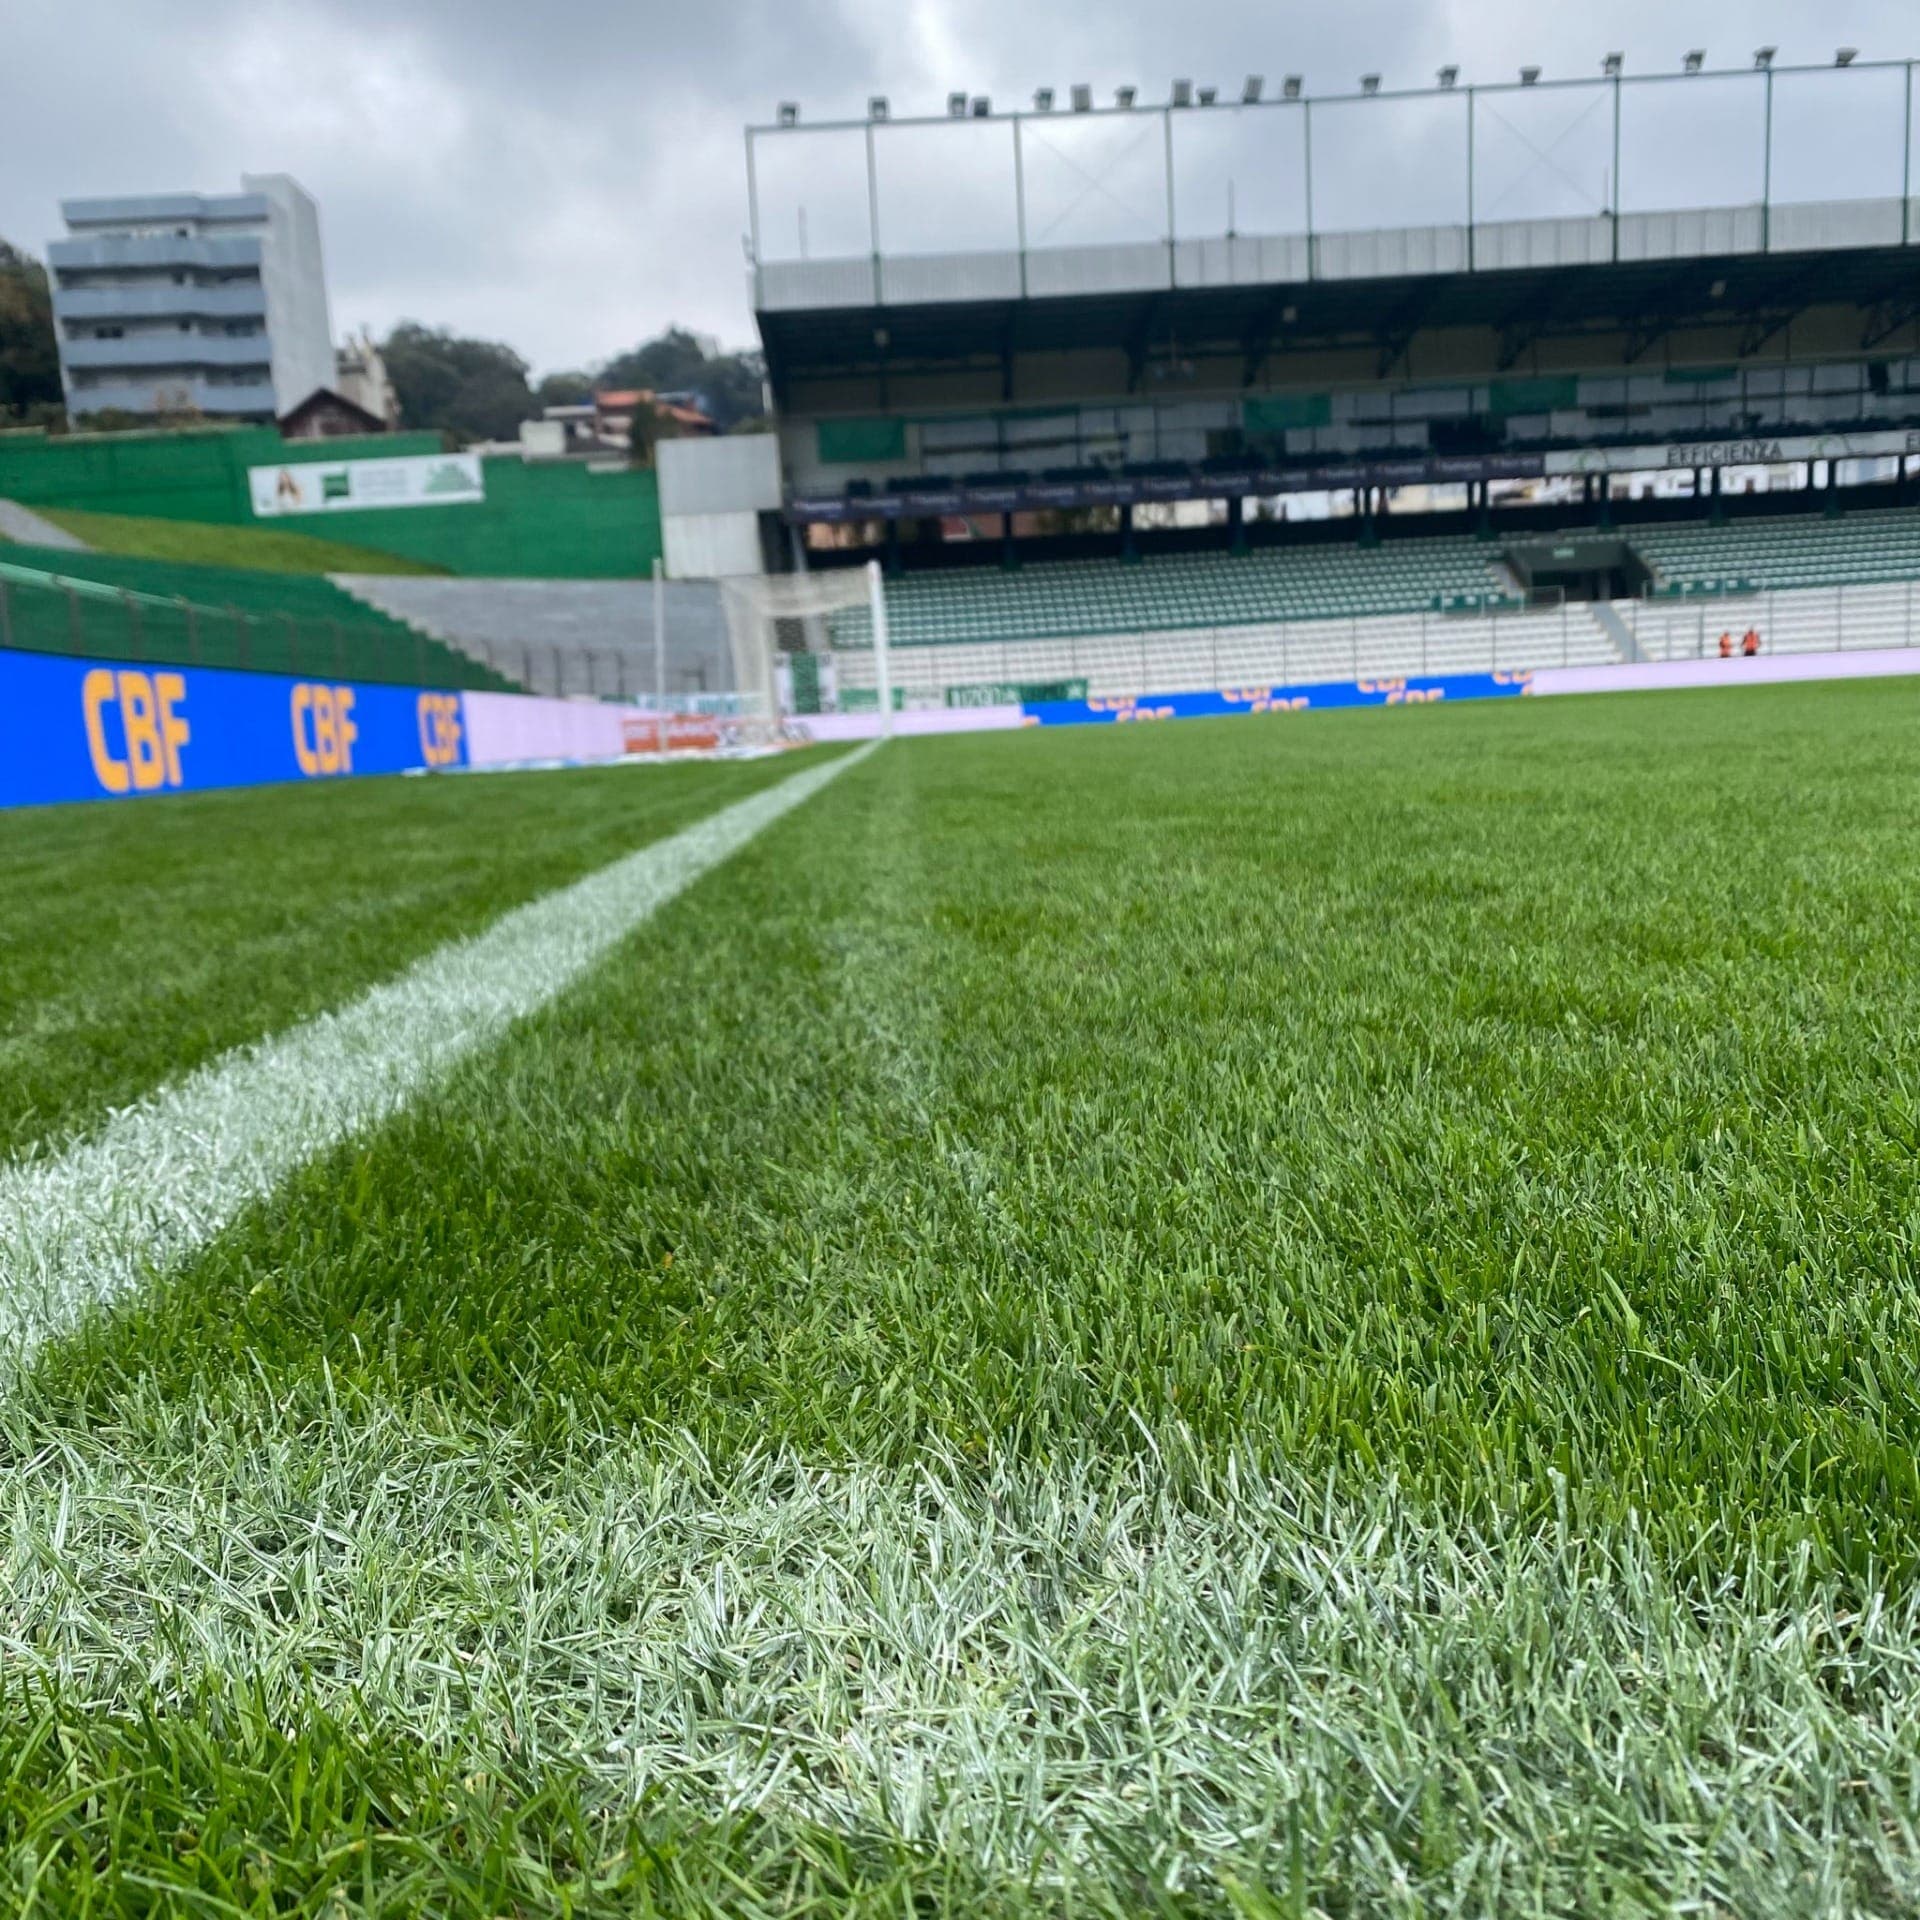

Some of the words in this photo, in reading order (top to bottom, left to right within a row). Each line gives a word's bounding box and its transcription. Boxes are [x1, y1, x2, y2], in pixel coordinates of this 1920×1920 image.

[83, 668, 189, 792] CBF
[291, 683, 357, 775] CBF
[418, 692, 461, 766] CBF
